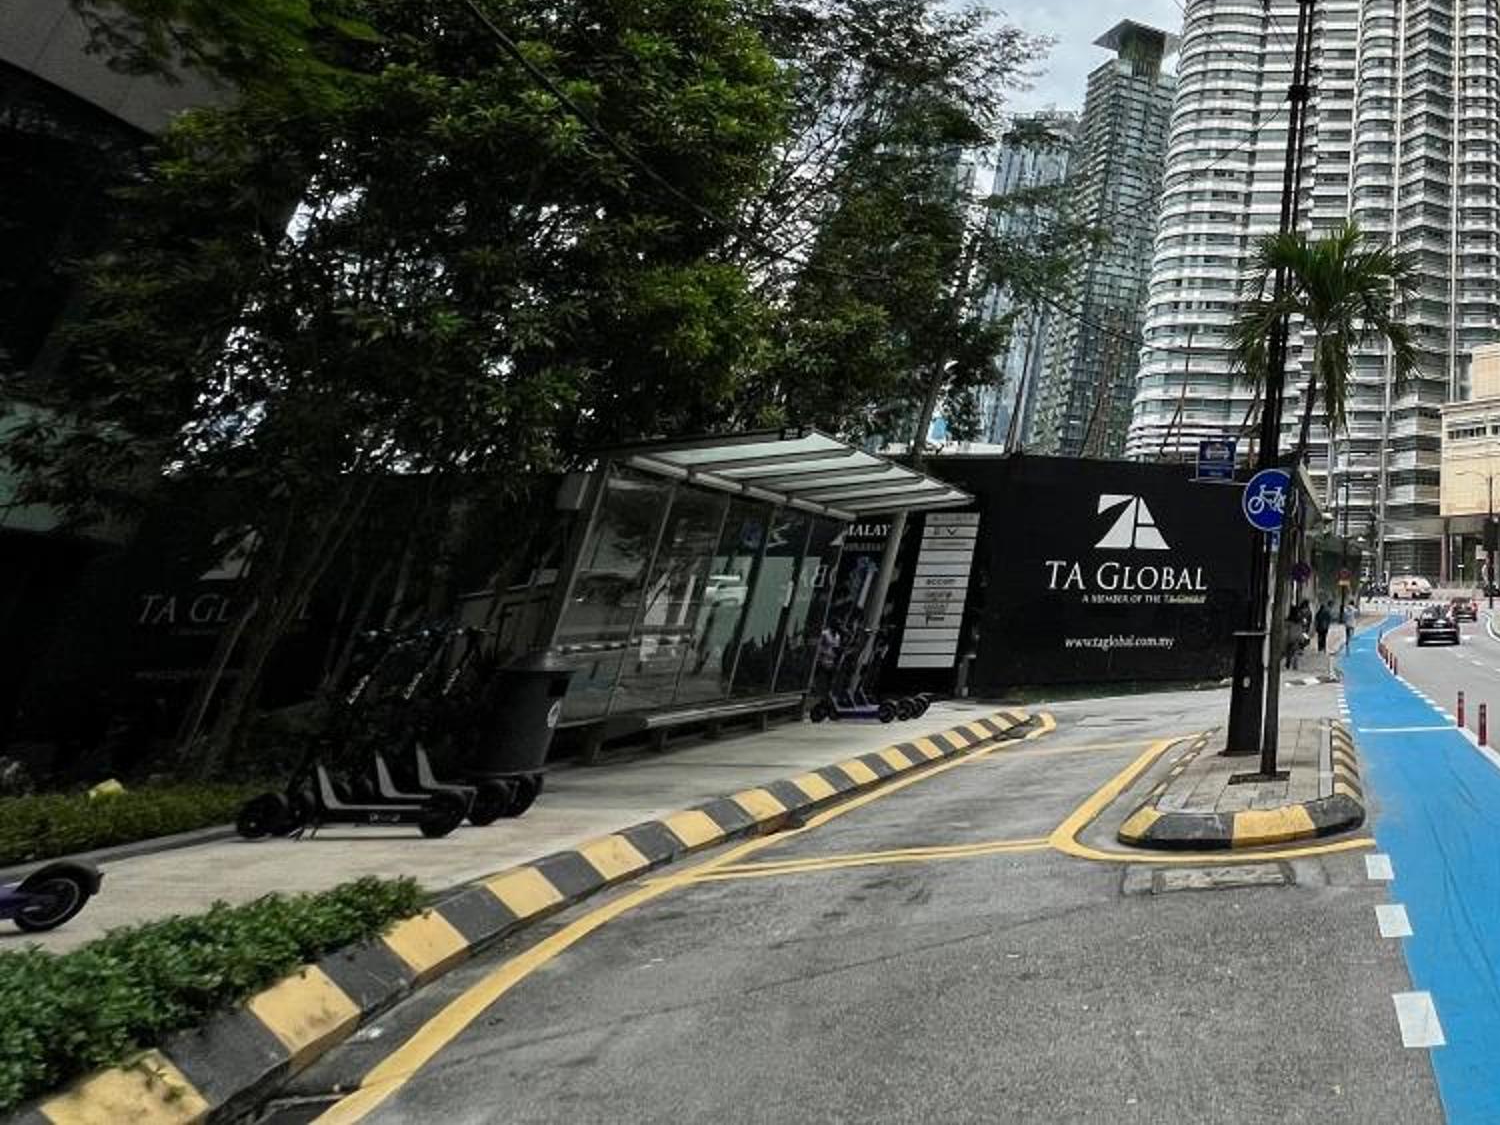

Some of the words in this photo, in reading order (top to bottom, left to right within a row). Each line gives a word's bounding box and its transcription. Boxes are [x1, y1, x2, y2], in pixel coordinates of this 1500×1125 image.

[1045, 560, 1086, 590] TA
[1096, 561, 1208, 590] GLOBAL
[138, 593, 177, 624] TA
[1081, 594, 1089, 604] A
[1129, 594, 1142, 604] OF
[1145, 594, 1161, 604] THE
